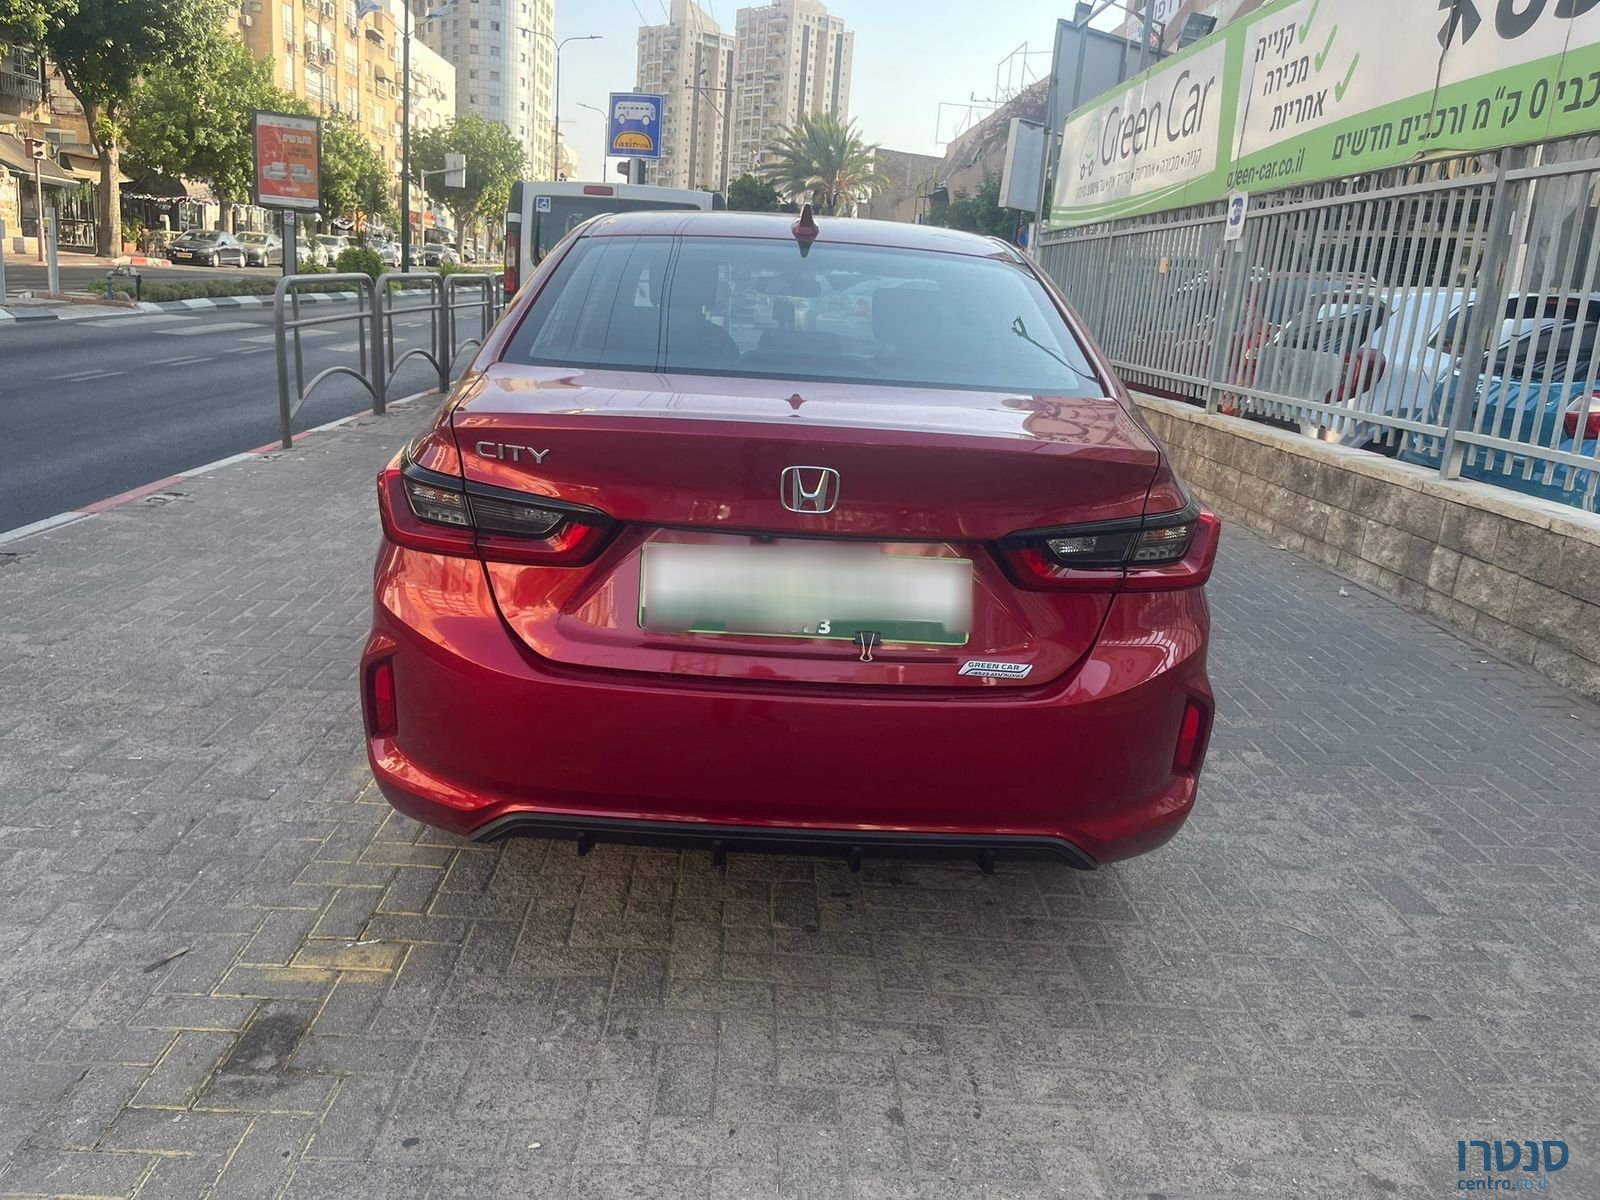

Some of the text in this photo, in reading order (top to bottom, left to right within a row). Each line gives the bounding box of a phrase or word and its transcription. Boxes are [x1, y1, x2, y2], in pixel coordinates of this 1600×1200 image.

[1255, 23, 1296, 63] קנייה
[1263, 55, 1310, 96] מכירה
[1101, 69, 1216, 166] Green Car
[1269, 89, 1328, 132] אחריות
[1331, 122, 1393, 161] חדשים
[475, 440, 550, 465] CITY
[967, 661, 1020, 671] GREEN CAR
